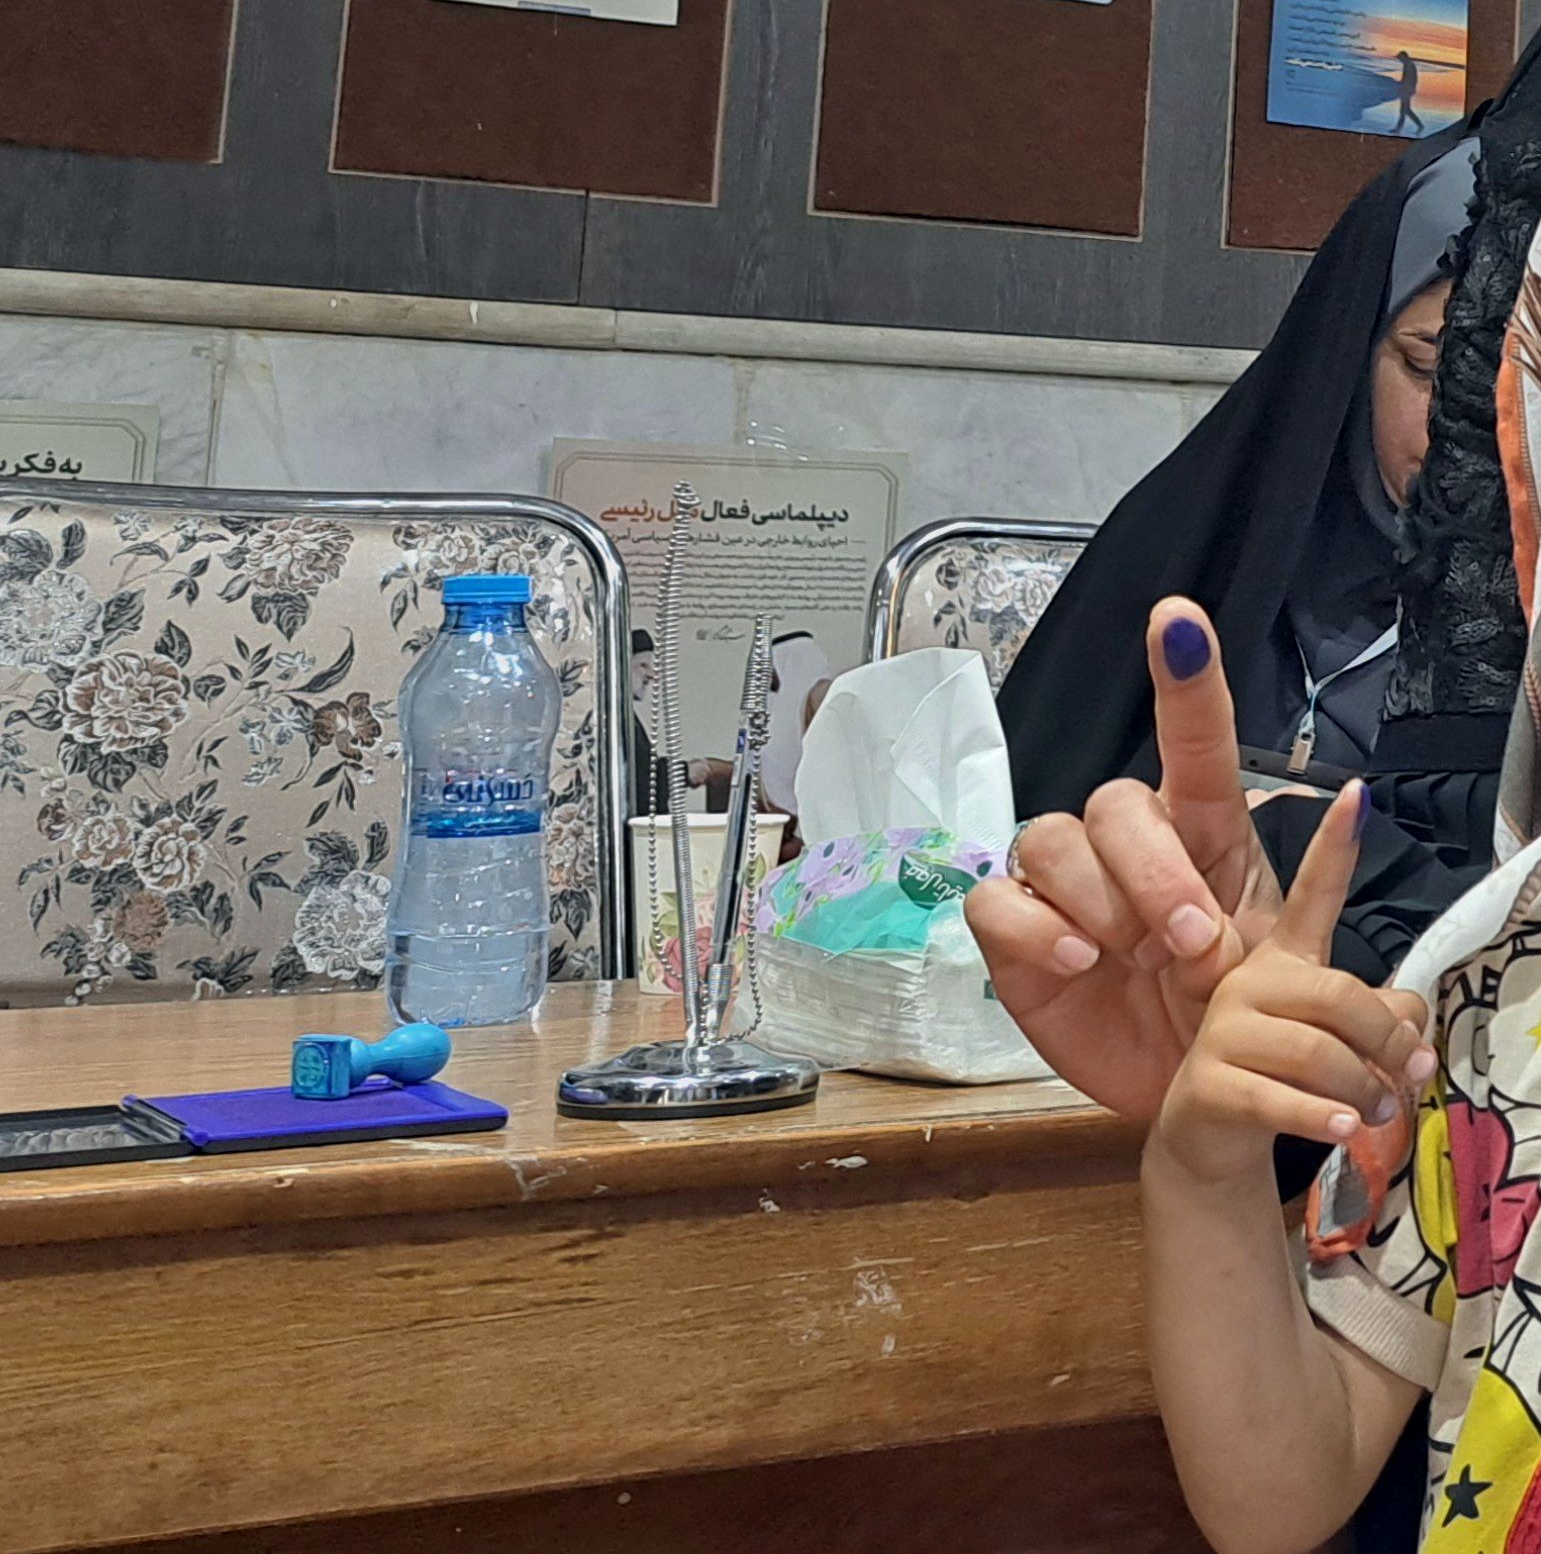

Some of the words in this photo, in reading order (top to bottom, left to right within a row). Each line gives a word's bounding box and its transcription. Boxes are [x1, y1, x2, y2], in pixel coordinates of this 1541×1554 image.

[4, 450, 56, 478] فکر
[59, 456, 83, 481] به
[657, 499, 700, 523] مل
[700, 498, 750, 522] فعال
[752, 502, 849, 532] دیپلماسی
[722, 534, 746, 547] عین
